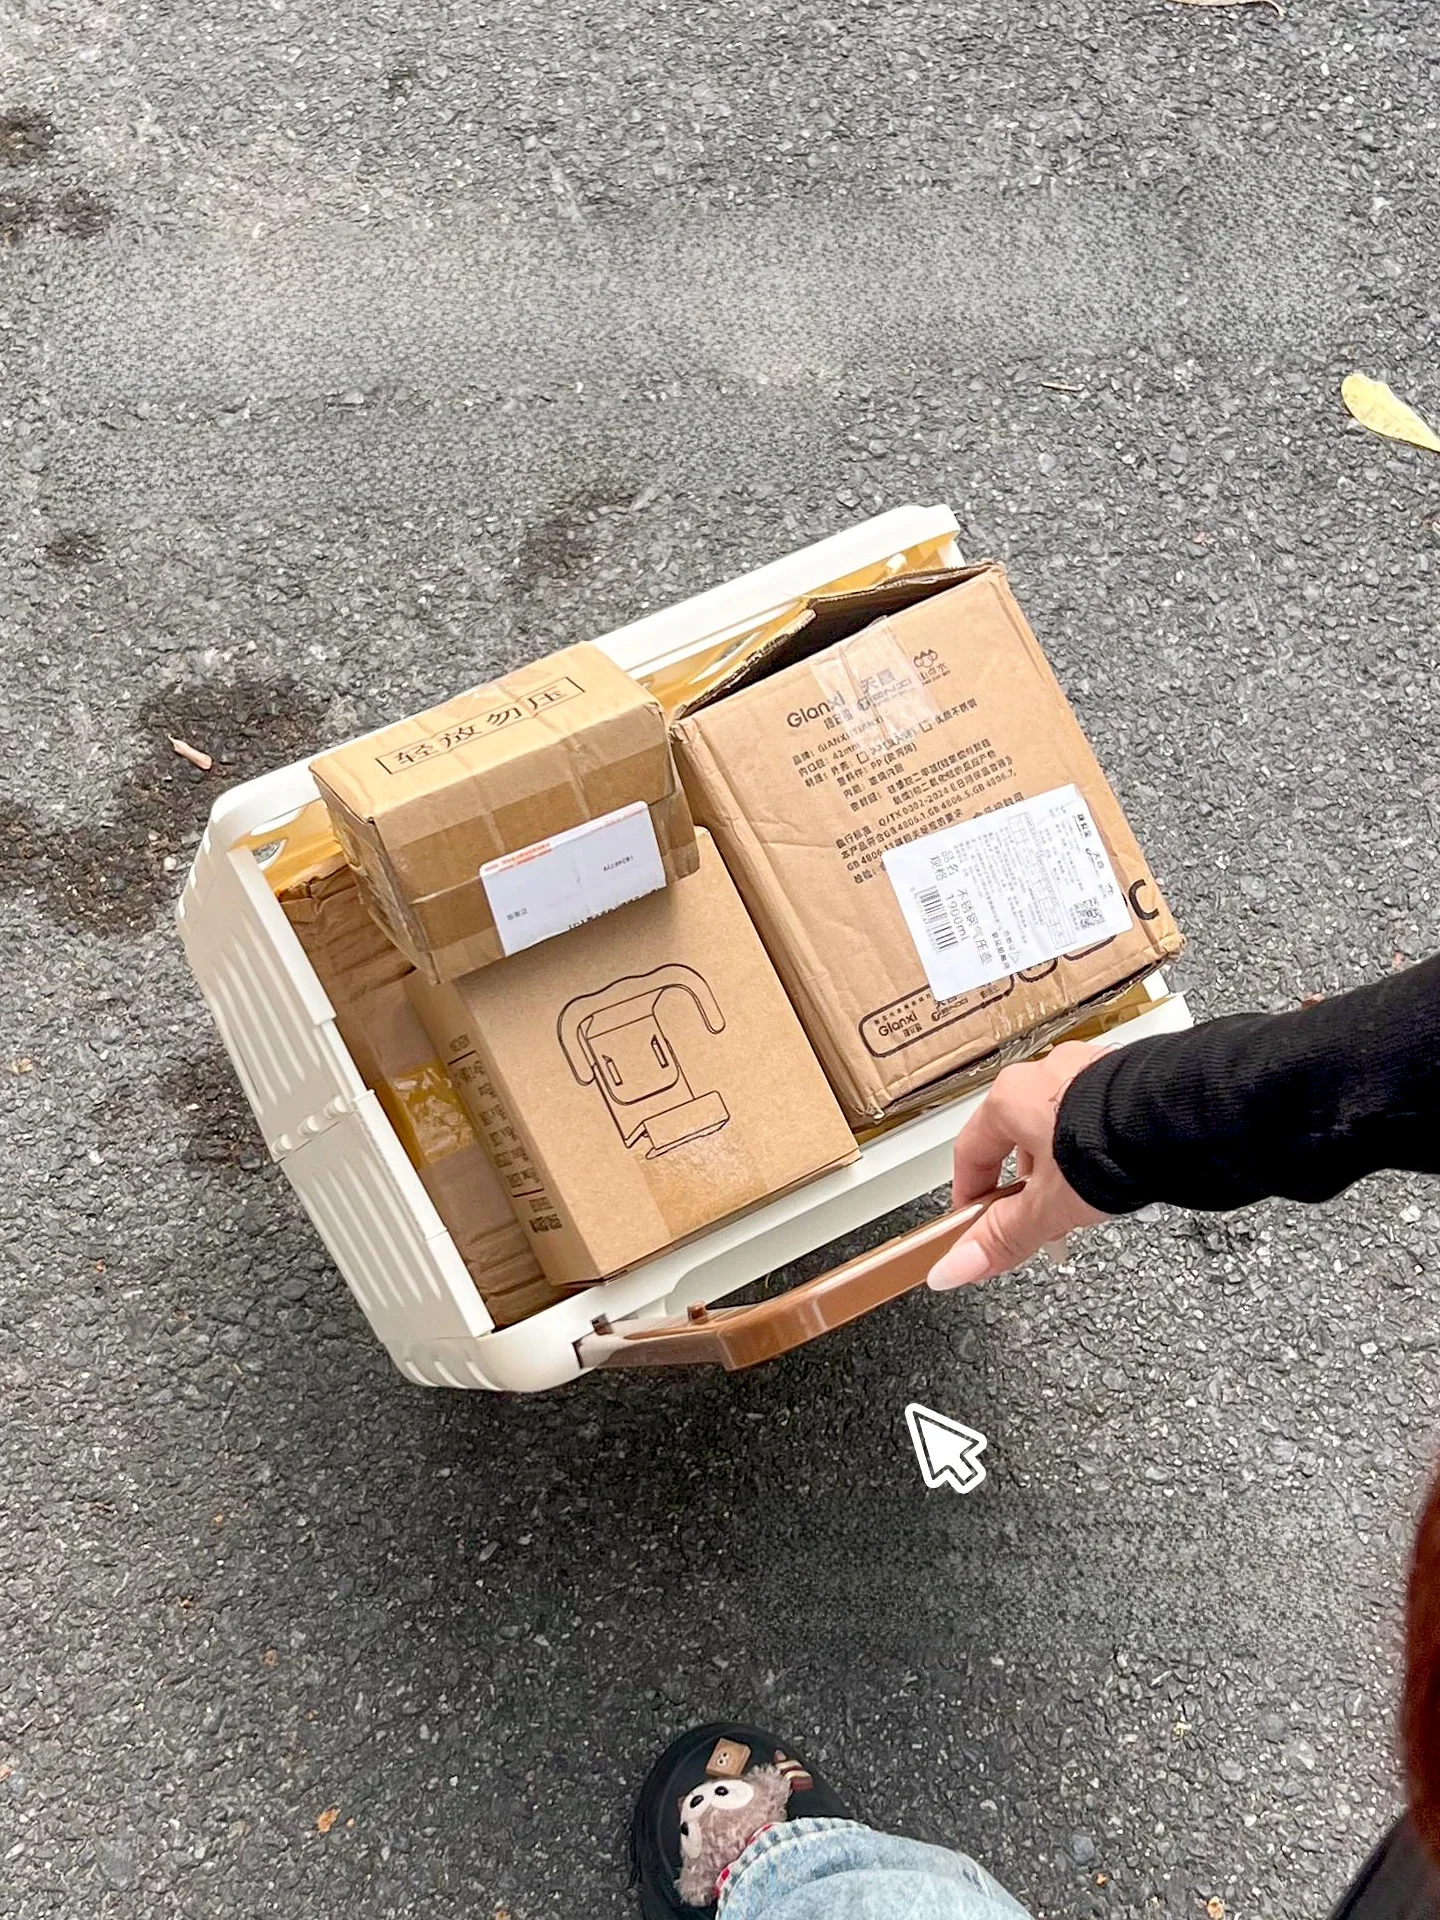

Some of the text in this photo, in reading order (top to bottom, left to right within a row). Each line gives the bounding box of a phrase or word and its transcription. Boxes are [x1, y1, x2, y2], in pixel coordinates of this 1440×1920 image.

[397, 685, 567, 762] 轻放勿压
[929, 855, 948, 881] 规格
[941, 849, 960, 875] 品名
[956, 887, 994, 964] 不锈钢气压壶
